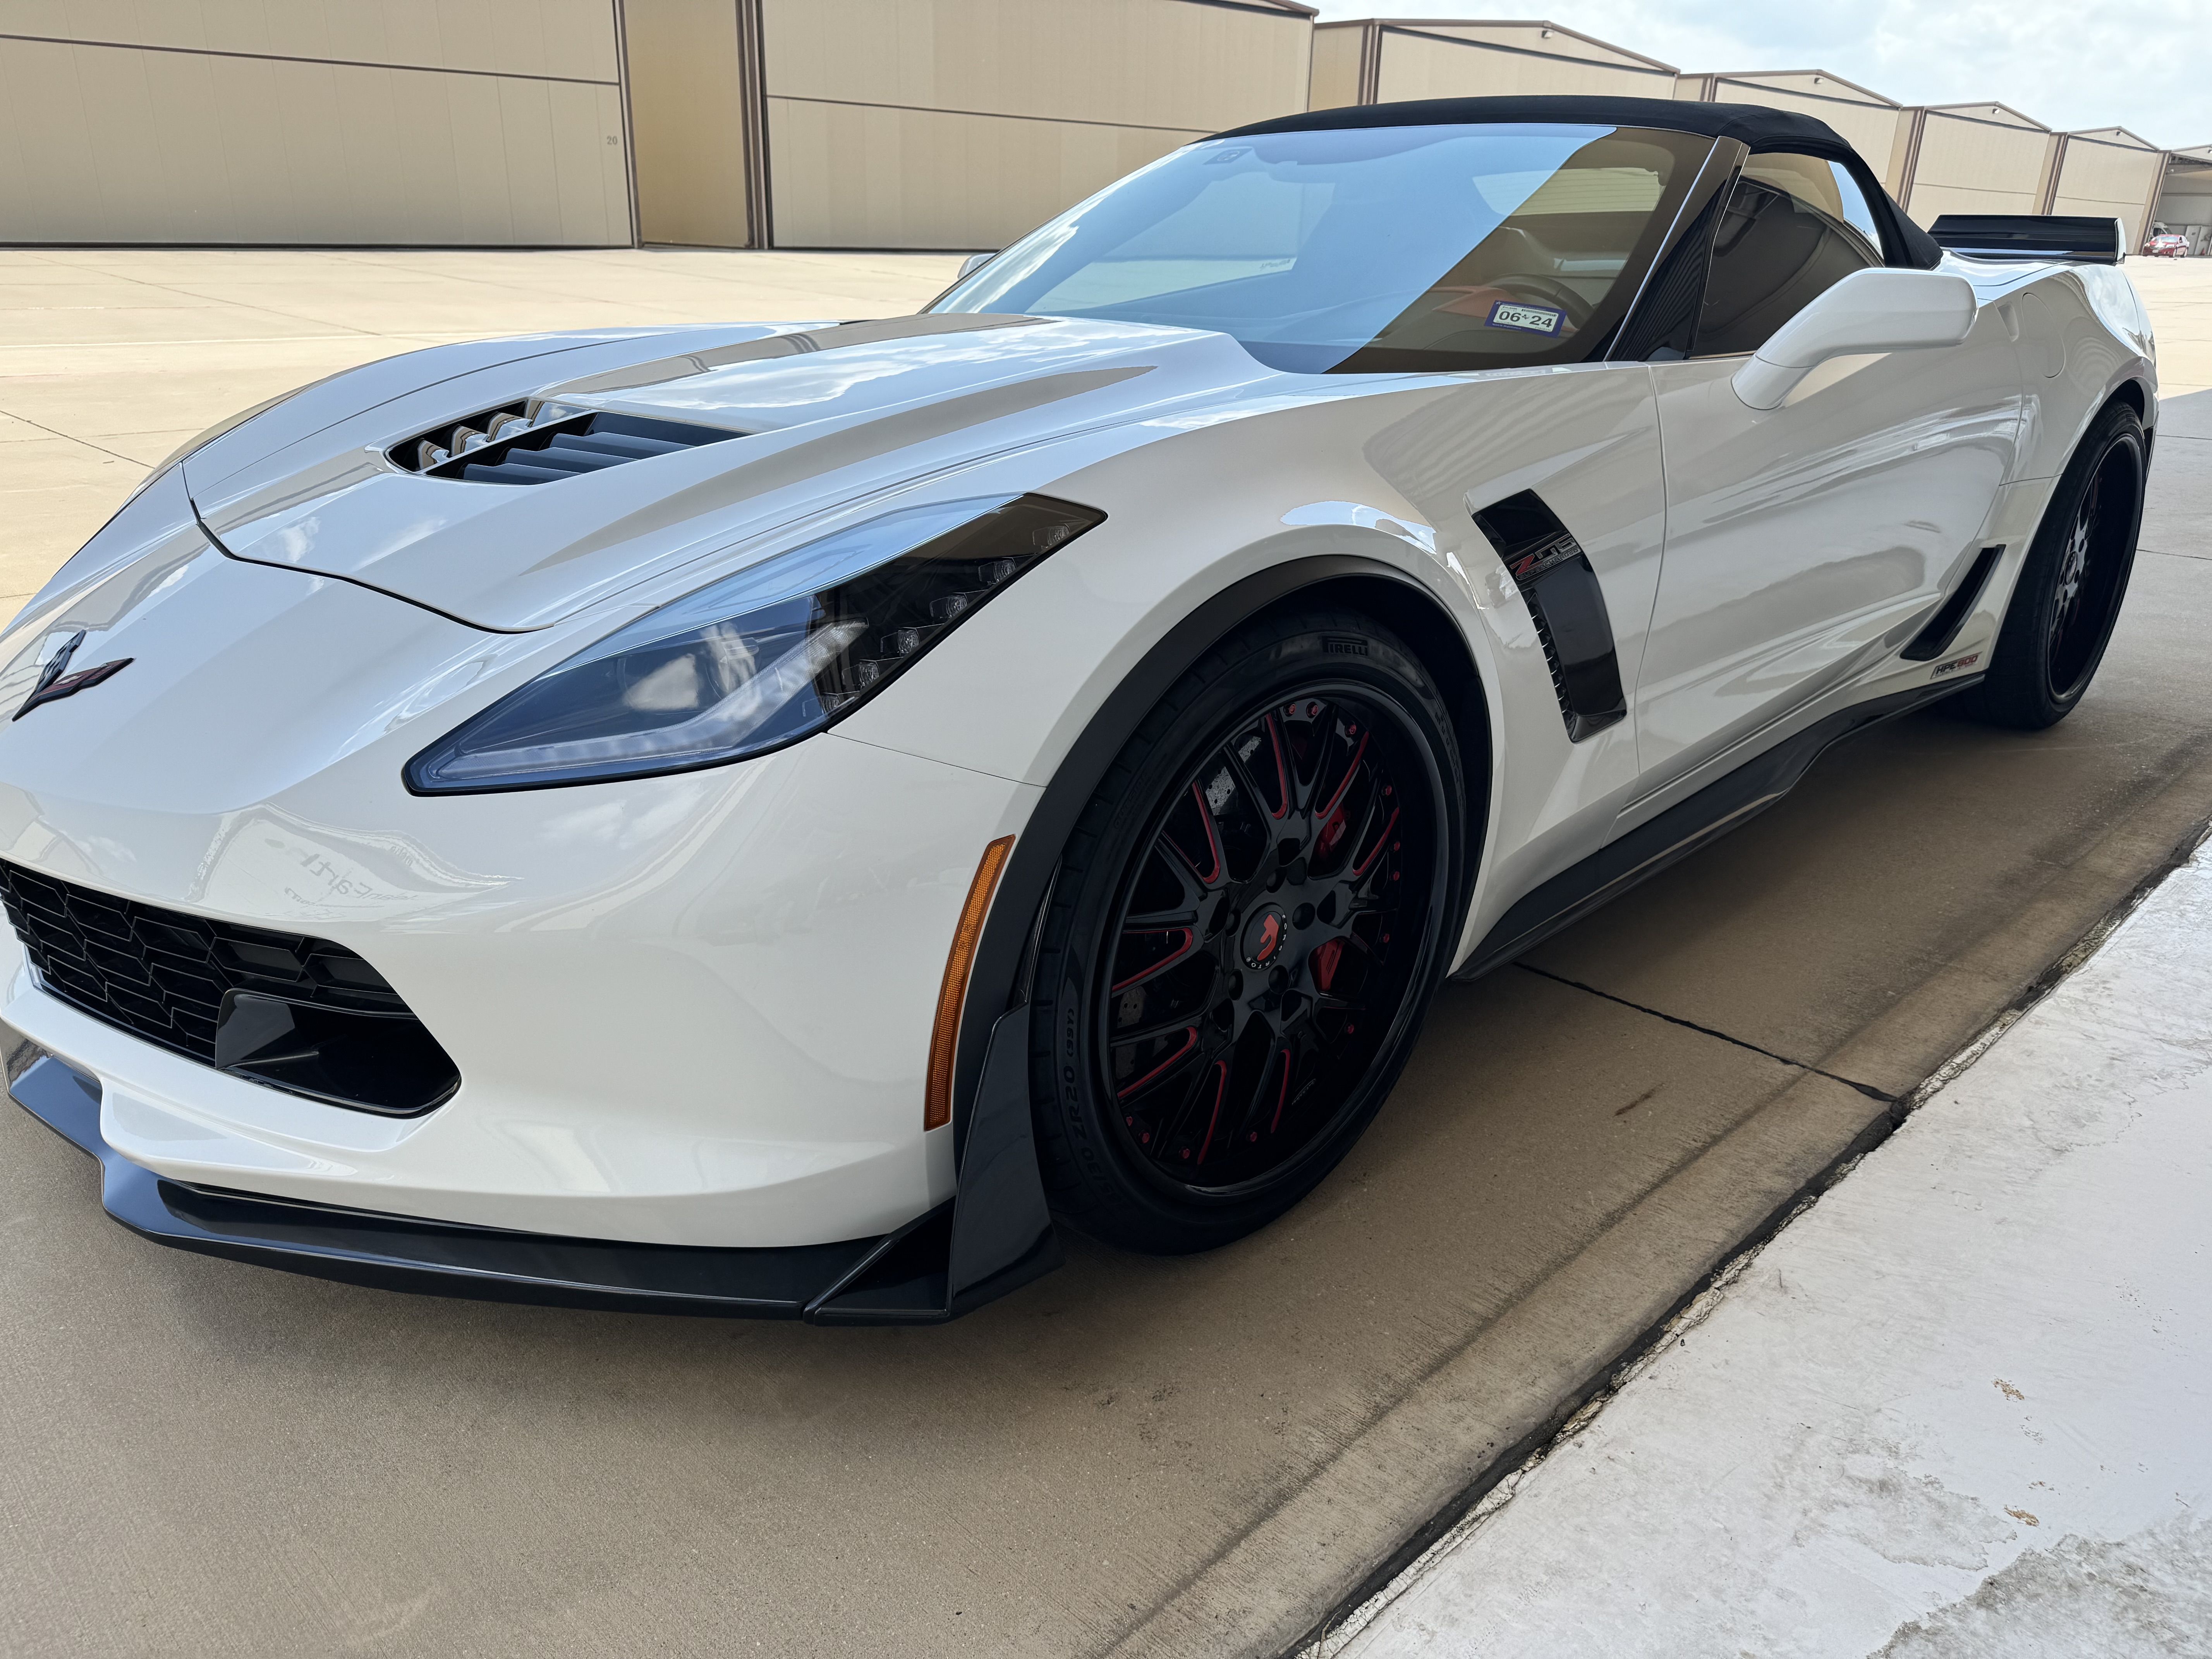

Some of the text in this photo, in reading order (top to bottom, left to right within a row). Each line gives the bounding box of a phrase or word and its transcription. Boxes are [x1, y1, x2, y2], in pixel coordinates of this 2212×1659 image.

[607, 136, 618, 145] 20
[1499, 311, 1522, 322] 06
[1529, 315, 1553, 328] 24
[1518, 548, 1579, 579] SUPERCHARGED
[1322, 636, 1368, 656] PIRELLI
[1066, 1008, 1075, 1058] (99Y)
[1063, 1065, 1087, 1140] ZR20
